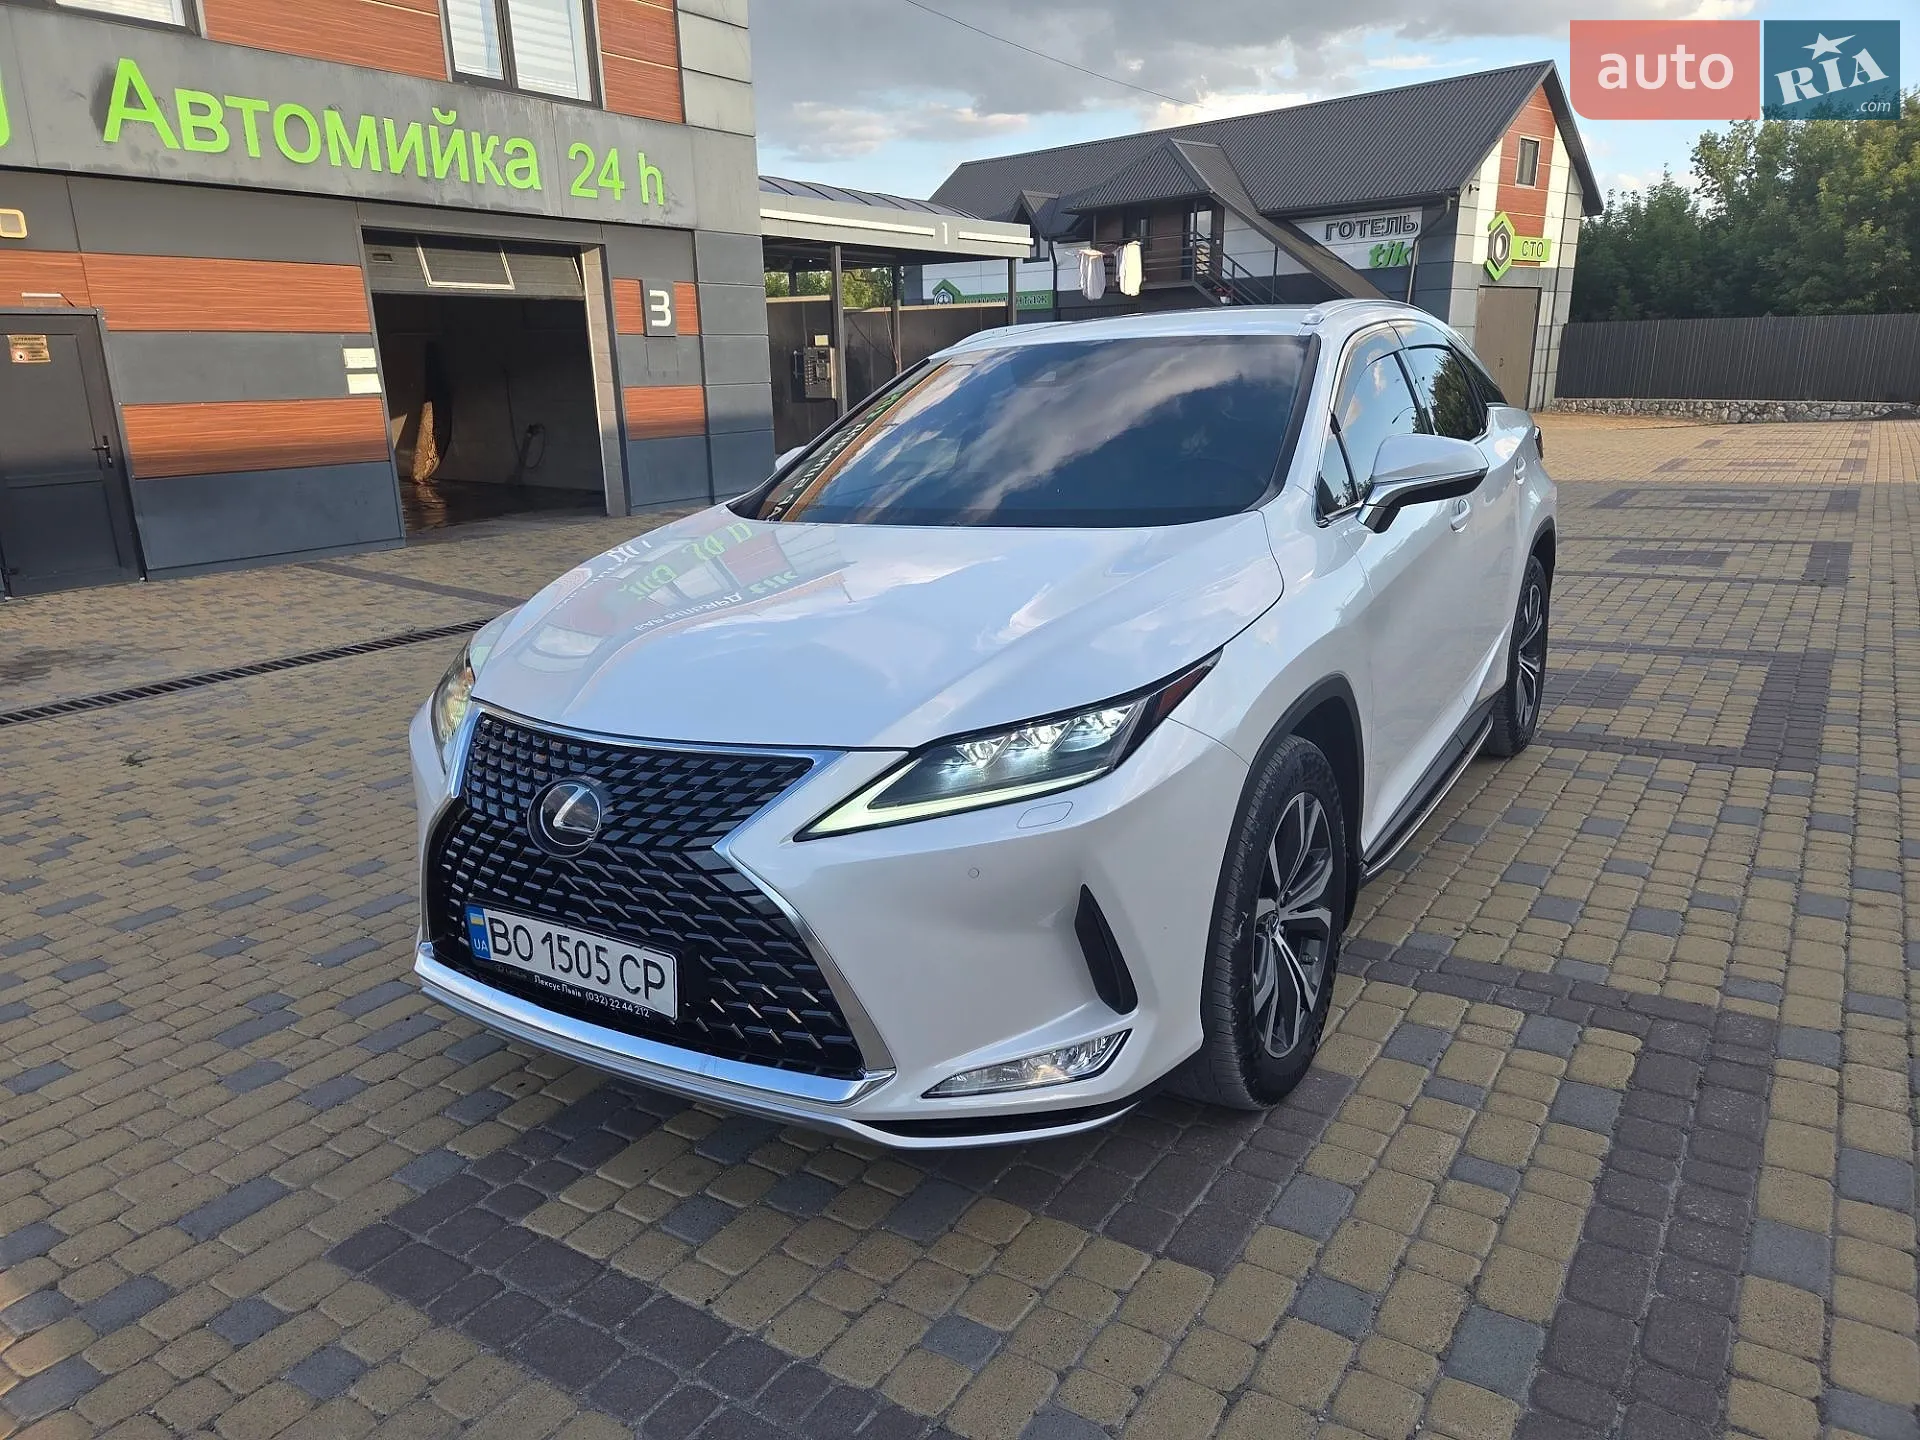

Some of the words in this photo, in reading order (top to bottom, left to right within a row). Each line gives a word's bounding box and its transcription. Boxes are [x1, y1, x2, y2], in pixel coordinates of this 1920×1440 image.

[103, 58, 542, 191] Автомийка
[567, 142, 625, 202] 24
[638, 152, 665, 206] h
[1325, 214, 1419, 241] ГОТЕЛЬ
[1369, 240, 1413, 268] tik
[1522, 240, 1544, 257] СТО
[649, 289, 672, 327] 3
[473, 937, 488, 951] UA
[487, 916, 534, 962] BO
[541, 930, 611, 985] 1505
[619, 953, 666, 1000] CP
[585, 991, 609, 1007] (032)
[609, 999, 621, 1009] 22
[621, 1002, 633, 1012] 44
[635, 1005, 650, 1018] 212
